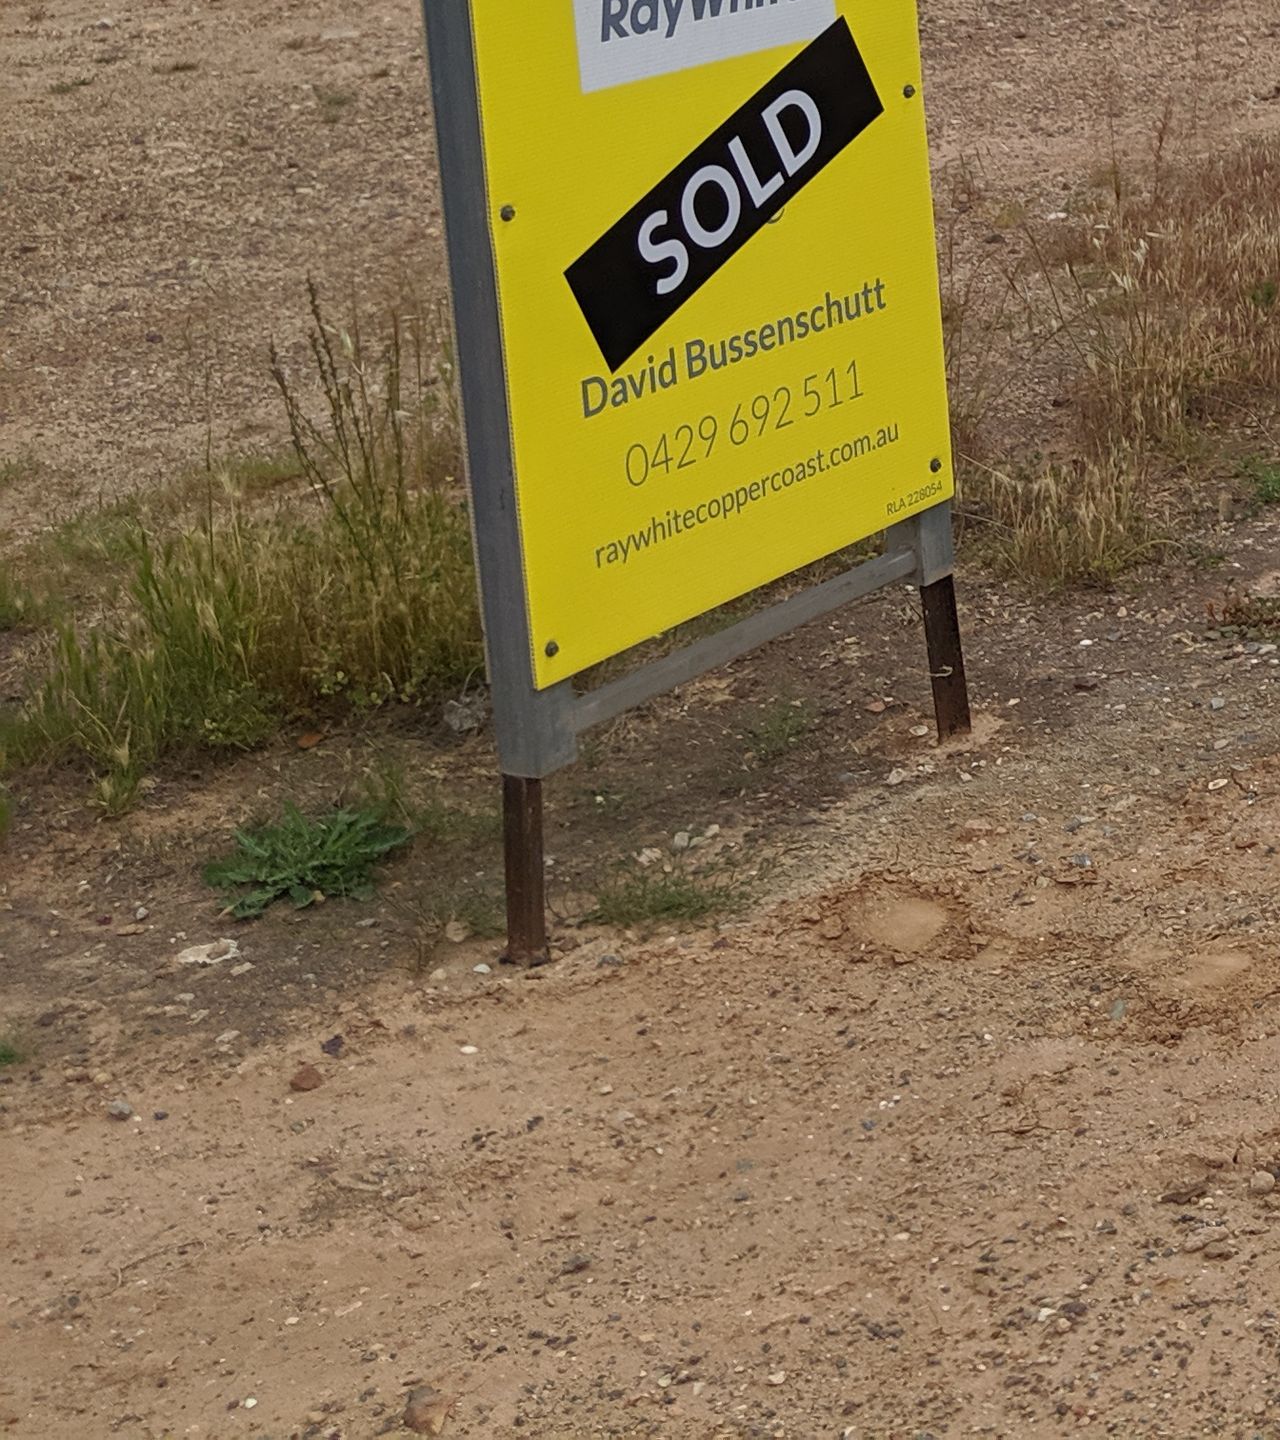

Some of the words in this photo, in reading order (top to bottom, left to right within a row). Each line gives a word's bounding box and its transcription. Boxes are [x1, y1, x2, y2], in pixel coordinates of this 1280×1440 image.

[637, 89, 822, 295] SOLD
[581, 347, 678, 418] David
[685, 278, 887, 379] Bussenschutt
[625, 415, 718, 486] 0429
[729, 386, 794, 445] 692
[804, 360, 864, 416] 511
[595, 423, 899, 568] raywhitecoppercoast.com.au
[886, 497, 907, 515] RLA
[907, 480, 943, 506] 228054
